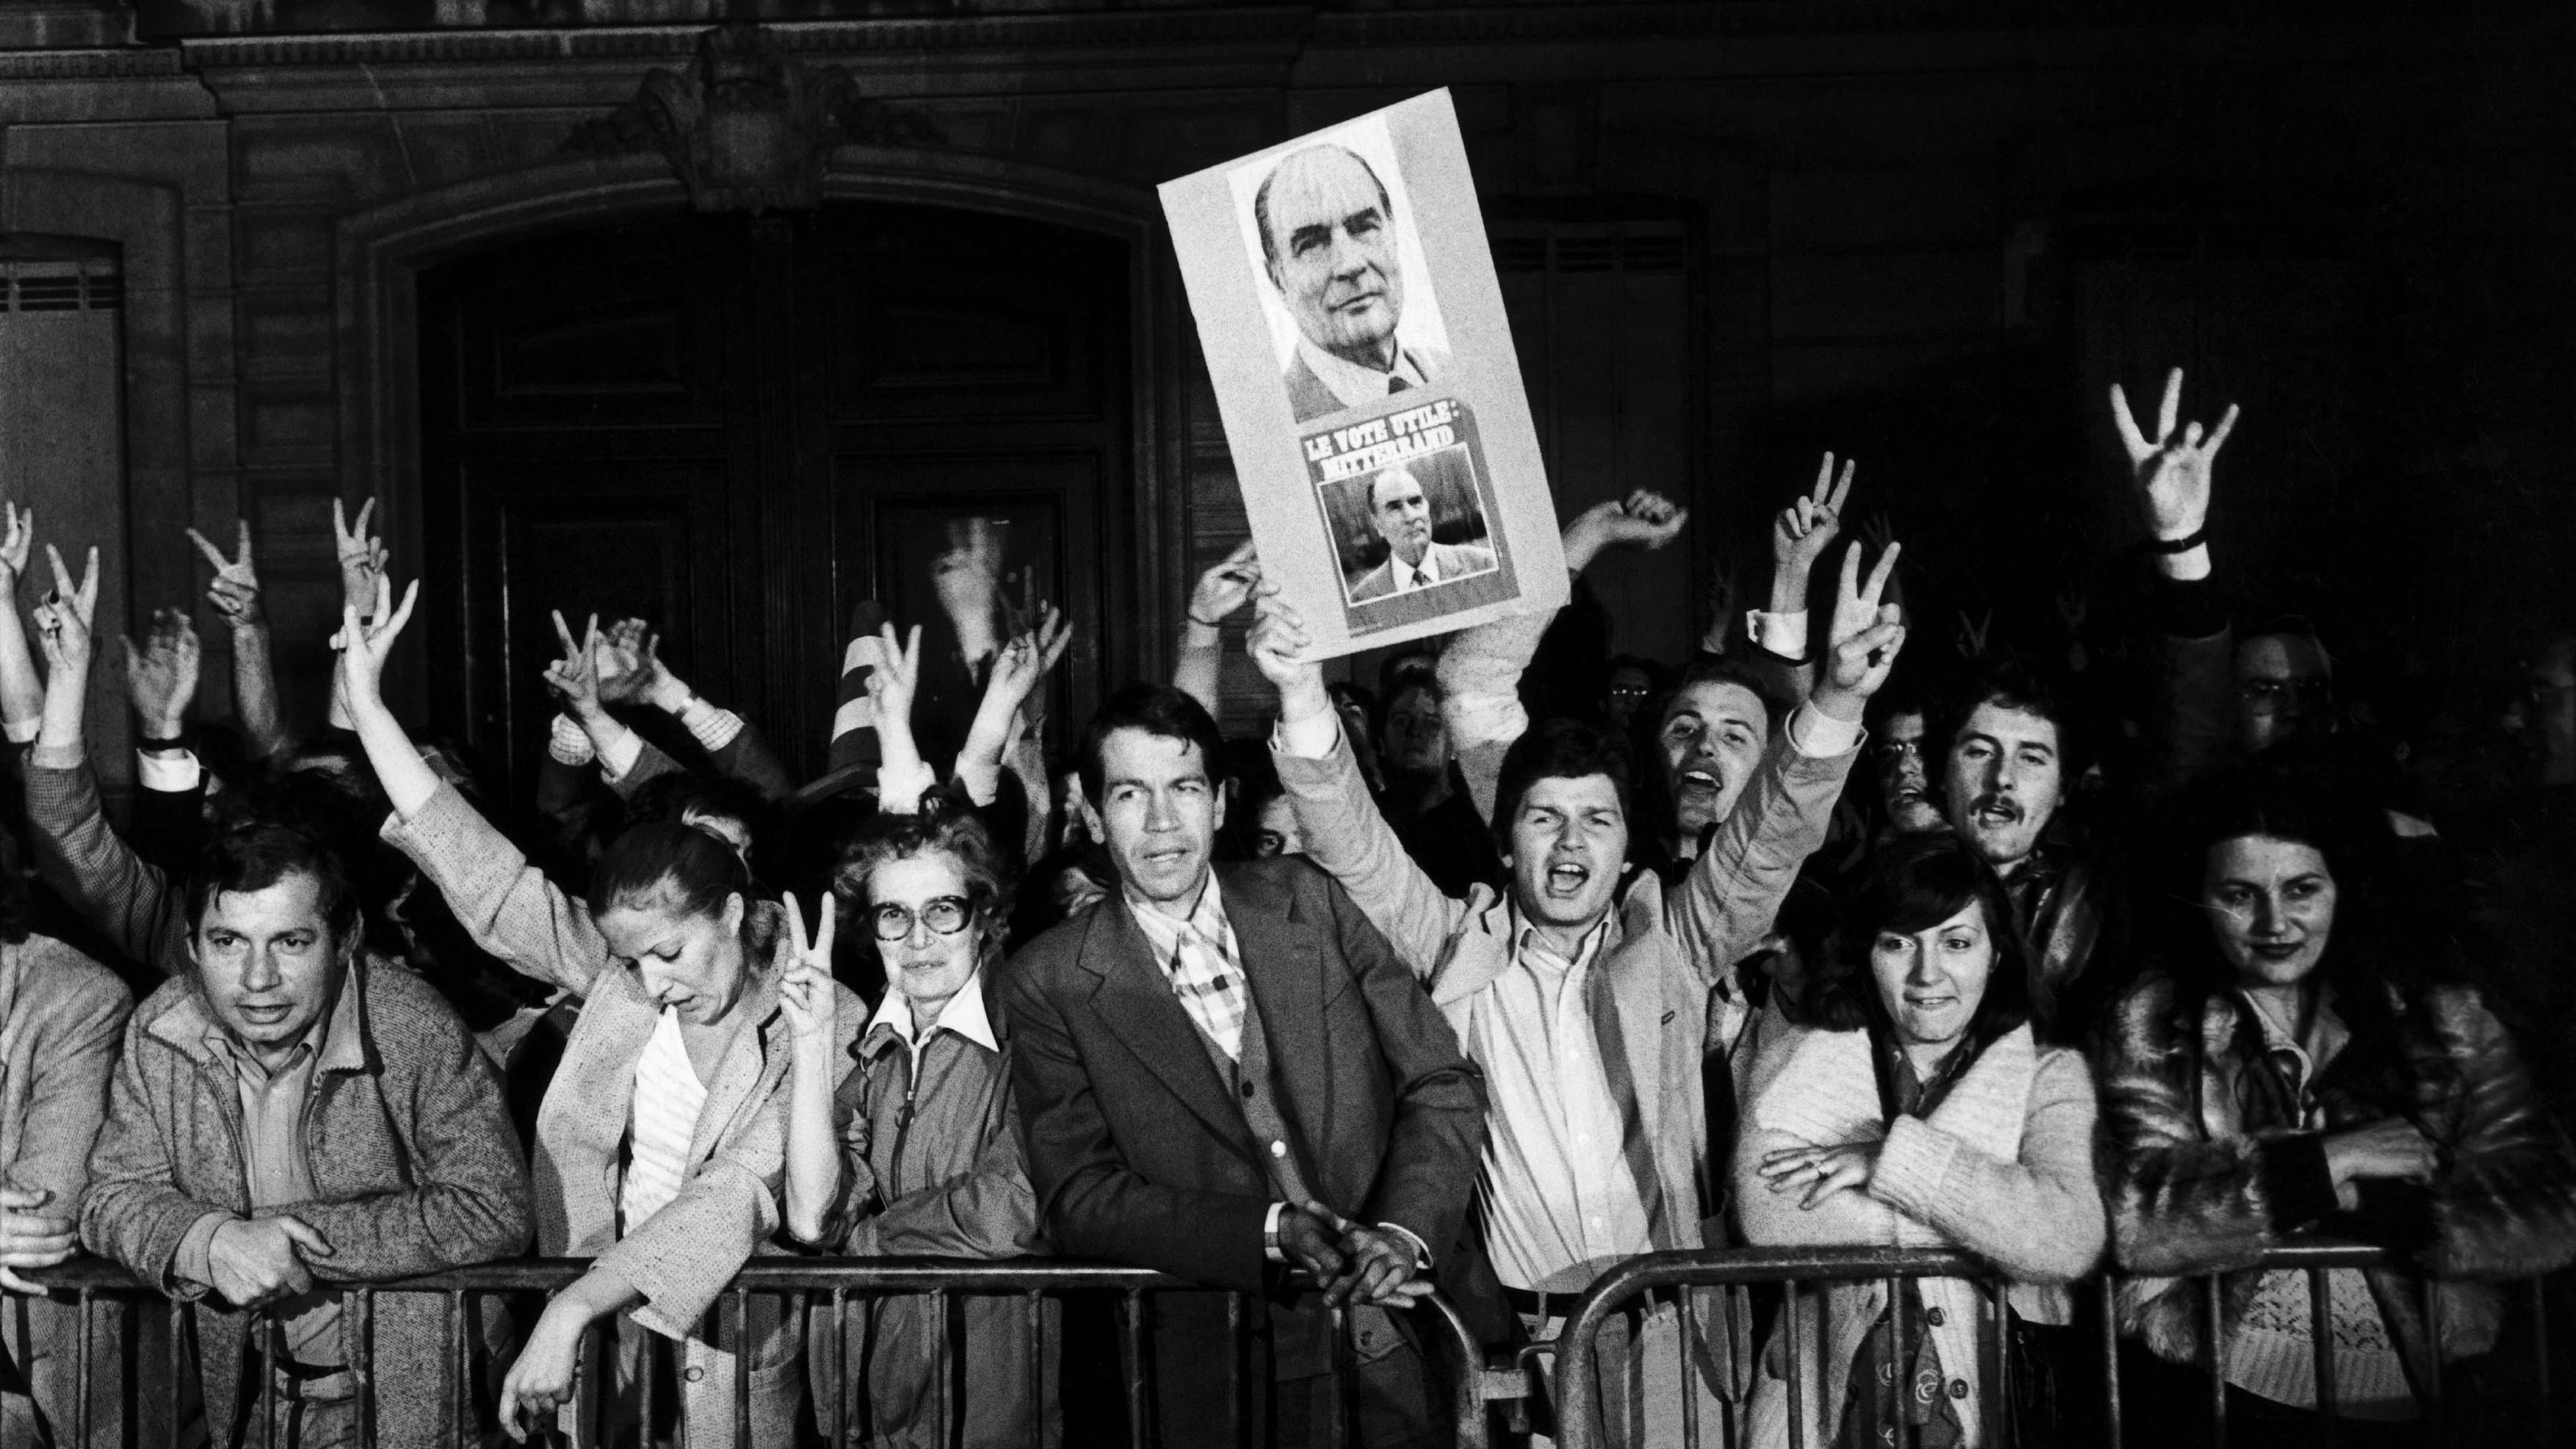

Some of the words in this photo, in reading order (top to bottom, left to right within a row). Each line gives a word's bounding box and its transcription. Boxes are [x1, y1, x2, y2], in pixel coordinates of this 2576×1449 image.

[1304, 435, 1332, 461] LE
[1334, 419, 1389, 452] VOTE
[1389, 400, 1459, 437] UTILE:
[1320, 425, 1455, 480] MITTERRAND
